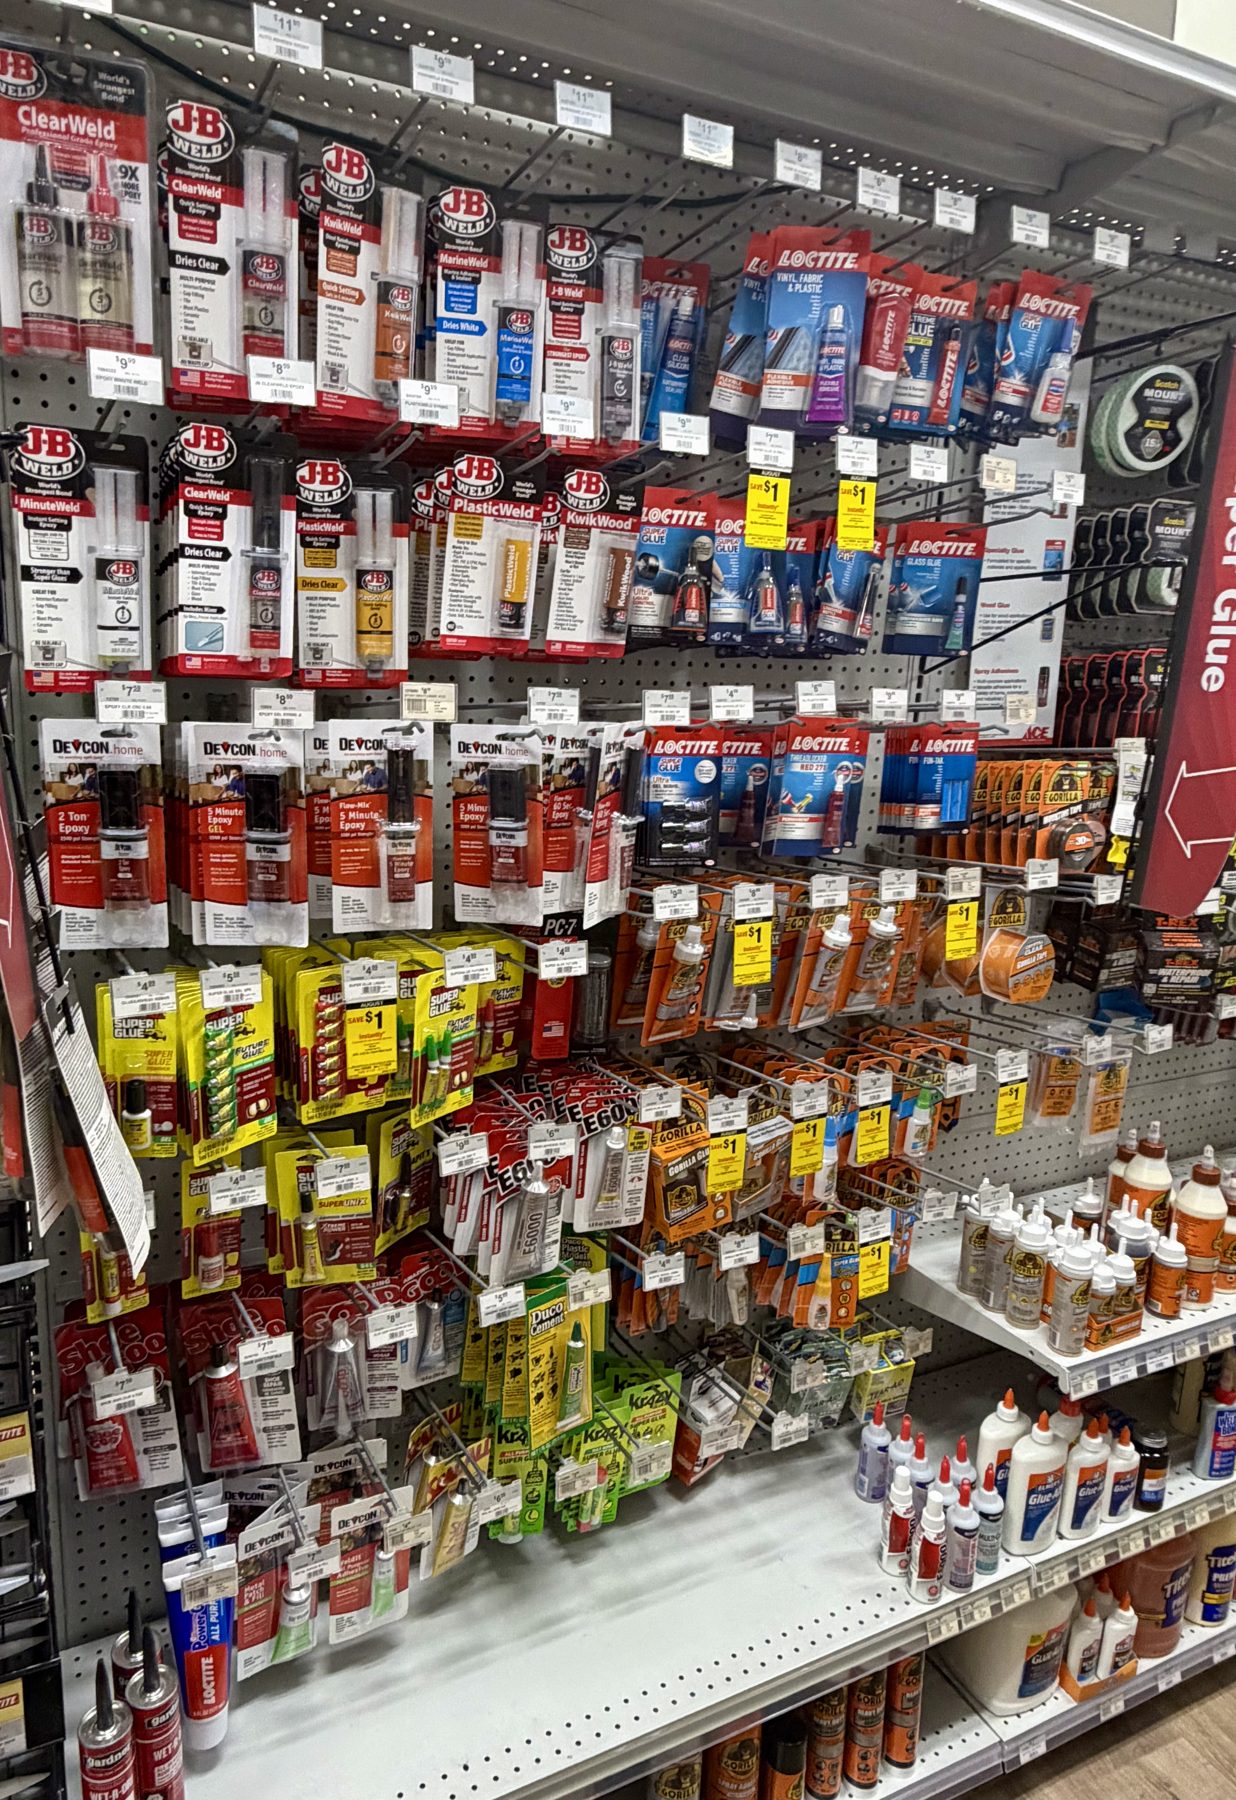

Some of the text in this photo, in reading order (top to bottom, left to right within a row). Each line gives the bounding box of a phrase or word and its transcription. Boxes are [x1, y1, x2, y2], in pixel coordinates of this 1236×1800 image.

[101, 92, 125, 103] Bond
[17, 104, 116, 141] ClearWeld
[172, 138, 223, 160] WELD
[172, 179, 222, 199] ClearWeld
[326, 177, 365, 198] WELD
[323, 215, 362, 237] KwikWeld
[442, 216, 484, 234] WELD
[174, 255, 219, 271] Dries Clear
[439, 250, 488, 269] MarineWeld
[549, 253, 588, 269] WELD
[777, 249, 859, 269] LOCTITE
[800, 272, 824, 285] FABRIC
[565, 288, 583, 299] Weld
[794, 282, 823, 294] PLASTIC
[914, 293, 969, 317] LOCTITE
[1019, 292, 1081, 318] LOCTITE
[442, 319, 480, 333] Dries White
[880, 310, 896, 352] LOCTITE
[1154, 379, 1179, 390] Scotch
[1143, 388, 1185, 401] MOUNT
[22, 459, 74, 475] WELD
[182, 453, 226, 470] WELD
[184, 487, 230, 502] ClearWeld
[299, 487, 342, 503] WELD
[457, 482, 495, 499] WELD
[763, 480, 779, 503] $1
[852, 485, 867, 507] $1
[19, 498, 80, 514] MinuteWeld
[453, 499, 534, 520] PlasticWeld
[566, 495, 602, 511] WELD
[566, 513, 634, 531] KwikWood
[641, 507, 708, 527] LOCTITE
[298, 521, 345, 533] PlasticWeld
[1154, 525, 1192, 537] MOUNT
[640, 534, 666, 546] GLUE
[184, 546, 222, 559] Dries Clear
[909, 539, 977, 557] LOCTITE
[907, 556, 927, 567] GLASS
[30, 567, 71, 579] Stronger than
[504, 544, 516, 598] PlasticWeld
[302, 577, 338, 590] Dries Clear
[618, 555, 634, 607] KwikWood
[1202, 589, 1236, 693] Glue
[1022, 727, 1049, 740] ACE
[114, 745, 143, 755] home
[505, 746, 529, 757] home
[654, 738, 720, 756] LOCTITE
[792, 737, 850, 751] LOCTITE
[925, 739, 975, 753] LOCTITE
[260, 748, 287, 759] home
[658, 764, 681, 773] GLUE
[800, 763, 814, 771] RED
[1045, 792, 1083, 803] GORILLA
[207, 807, 242, 817] 5 Minute
[339, 810, 380, 820] 5 Minute
[460, 804, 466, 813] 5
[59, 812, 86, 821] 2 Ton
[207, 816, 233, 827] Epoxy
[460, 813, 484, 824] Epoxy
[59, 822, 90, 836] Epoxy
[208, 825, 224, 834] GEL
[339, 820, 366, 832] Epoxy
[992, 916, 1024, 927] GORILLA
[748, 926, 762, 944] $1
[360, 999, 385, 1009] AUGUST
[429, 990, 460, 1010] SUPER
[113, 1019, 155, 1029] SUPER
[205, 1013, 244, 1032] SUPER
[347, 1010, 384, 1030] SAVE $1
[113, 1028, 145, 1038] GLUE
[870, 1110, 882, 1125] $1
[660, 1123, 703, 1144] GORILLA
[805, 1122, 819, 1139] $1
[722, 1138, 738, 1155] $1
[668, 1162, 696, 1177] GORILLA
[523, 1212, 543, 1256] E6000
[870, 1247, 883, 1261] $1
[531, 1302, 564, 1323] Duco
[530, 1316, 565, 1337] Cement
[203, 1656, 215, 1706] LOCTITE
[723, 1757, 757, 1770] GORIL
